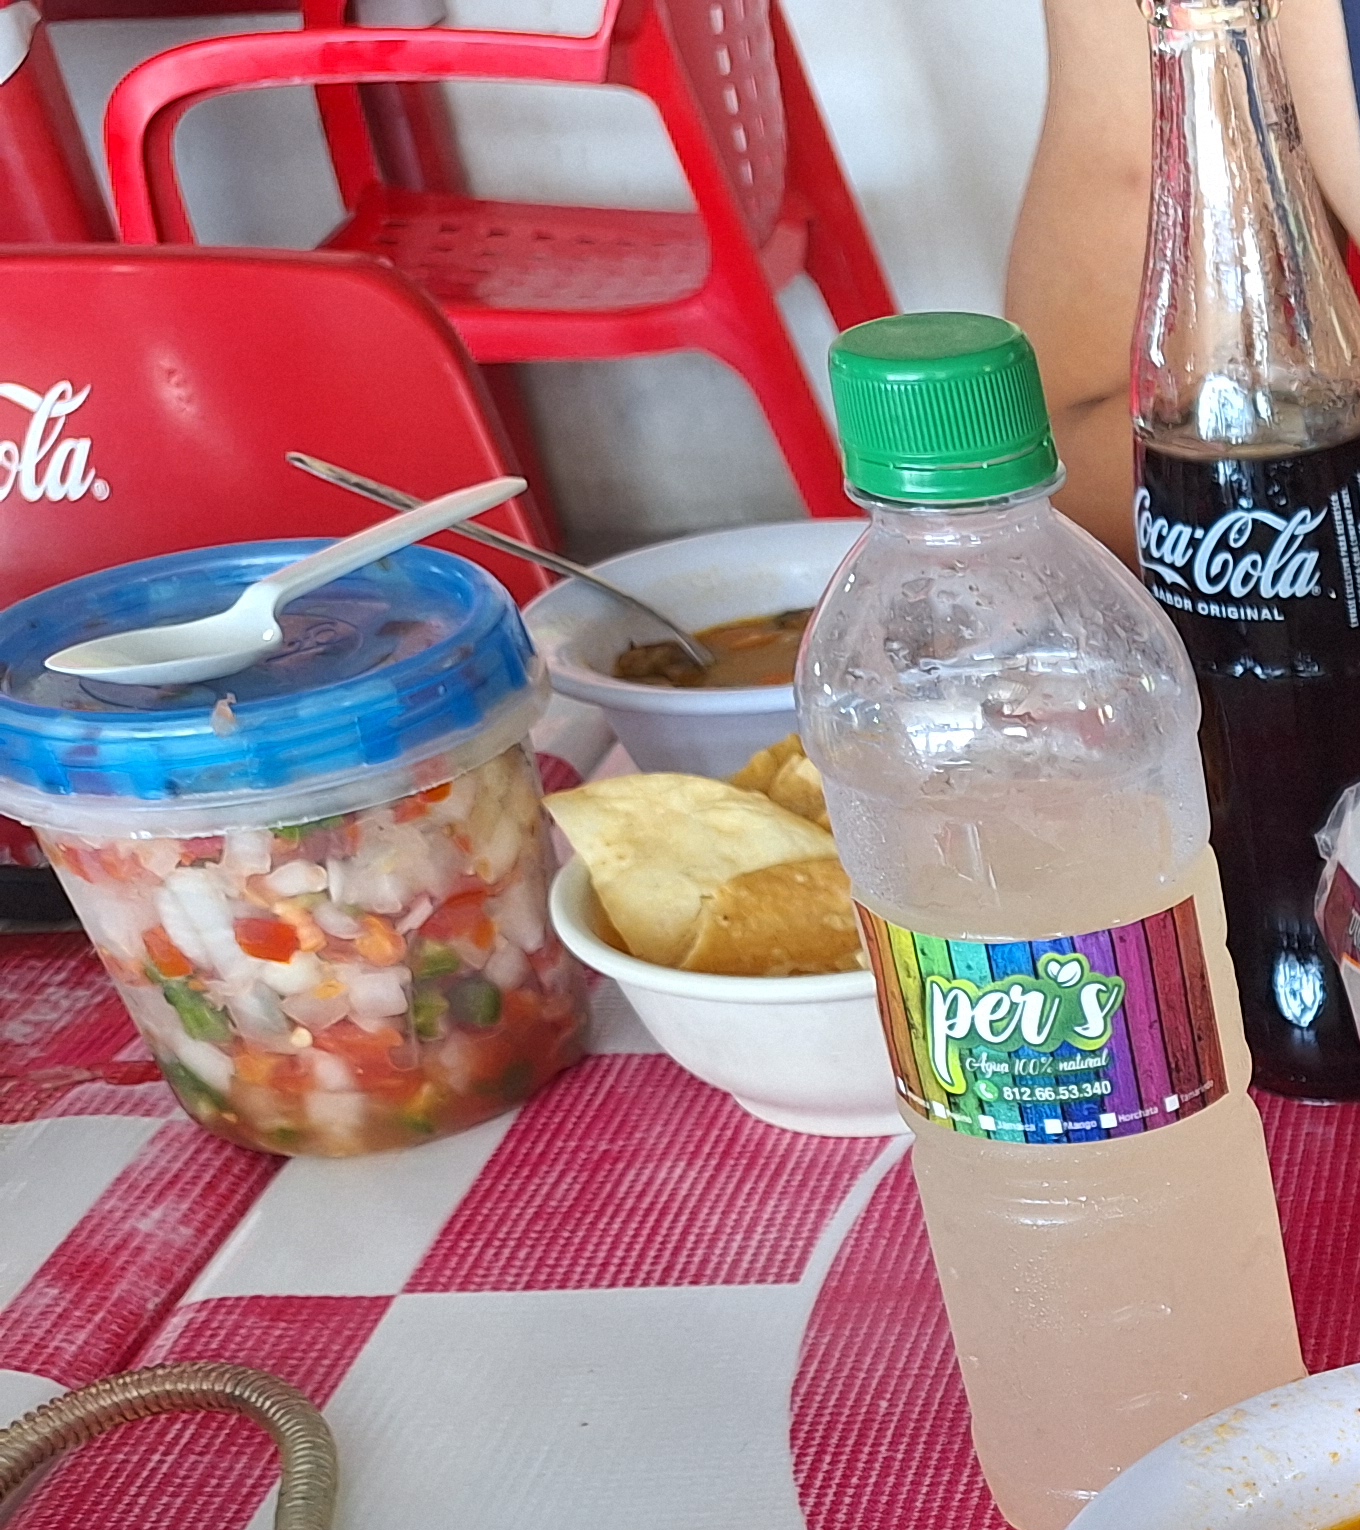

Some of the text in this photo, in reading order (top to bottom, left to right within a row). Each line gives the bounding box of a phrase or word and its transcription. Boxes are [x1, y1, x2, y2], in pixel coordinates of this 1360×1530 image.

[0, 379, 96, 502] ola
[1134, 488, 1329, 599] Coca-Cola
[1152, 584, 1285, 621] SABOR ORIGINAL
[965, 1048, 1110, 1079] Agua 100% natural
[1002, 1080, 1112, 1101] 812.66.53.340
[1118, 1106, 1159, 1123] Horchata
